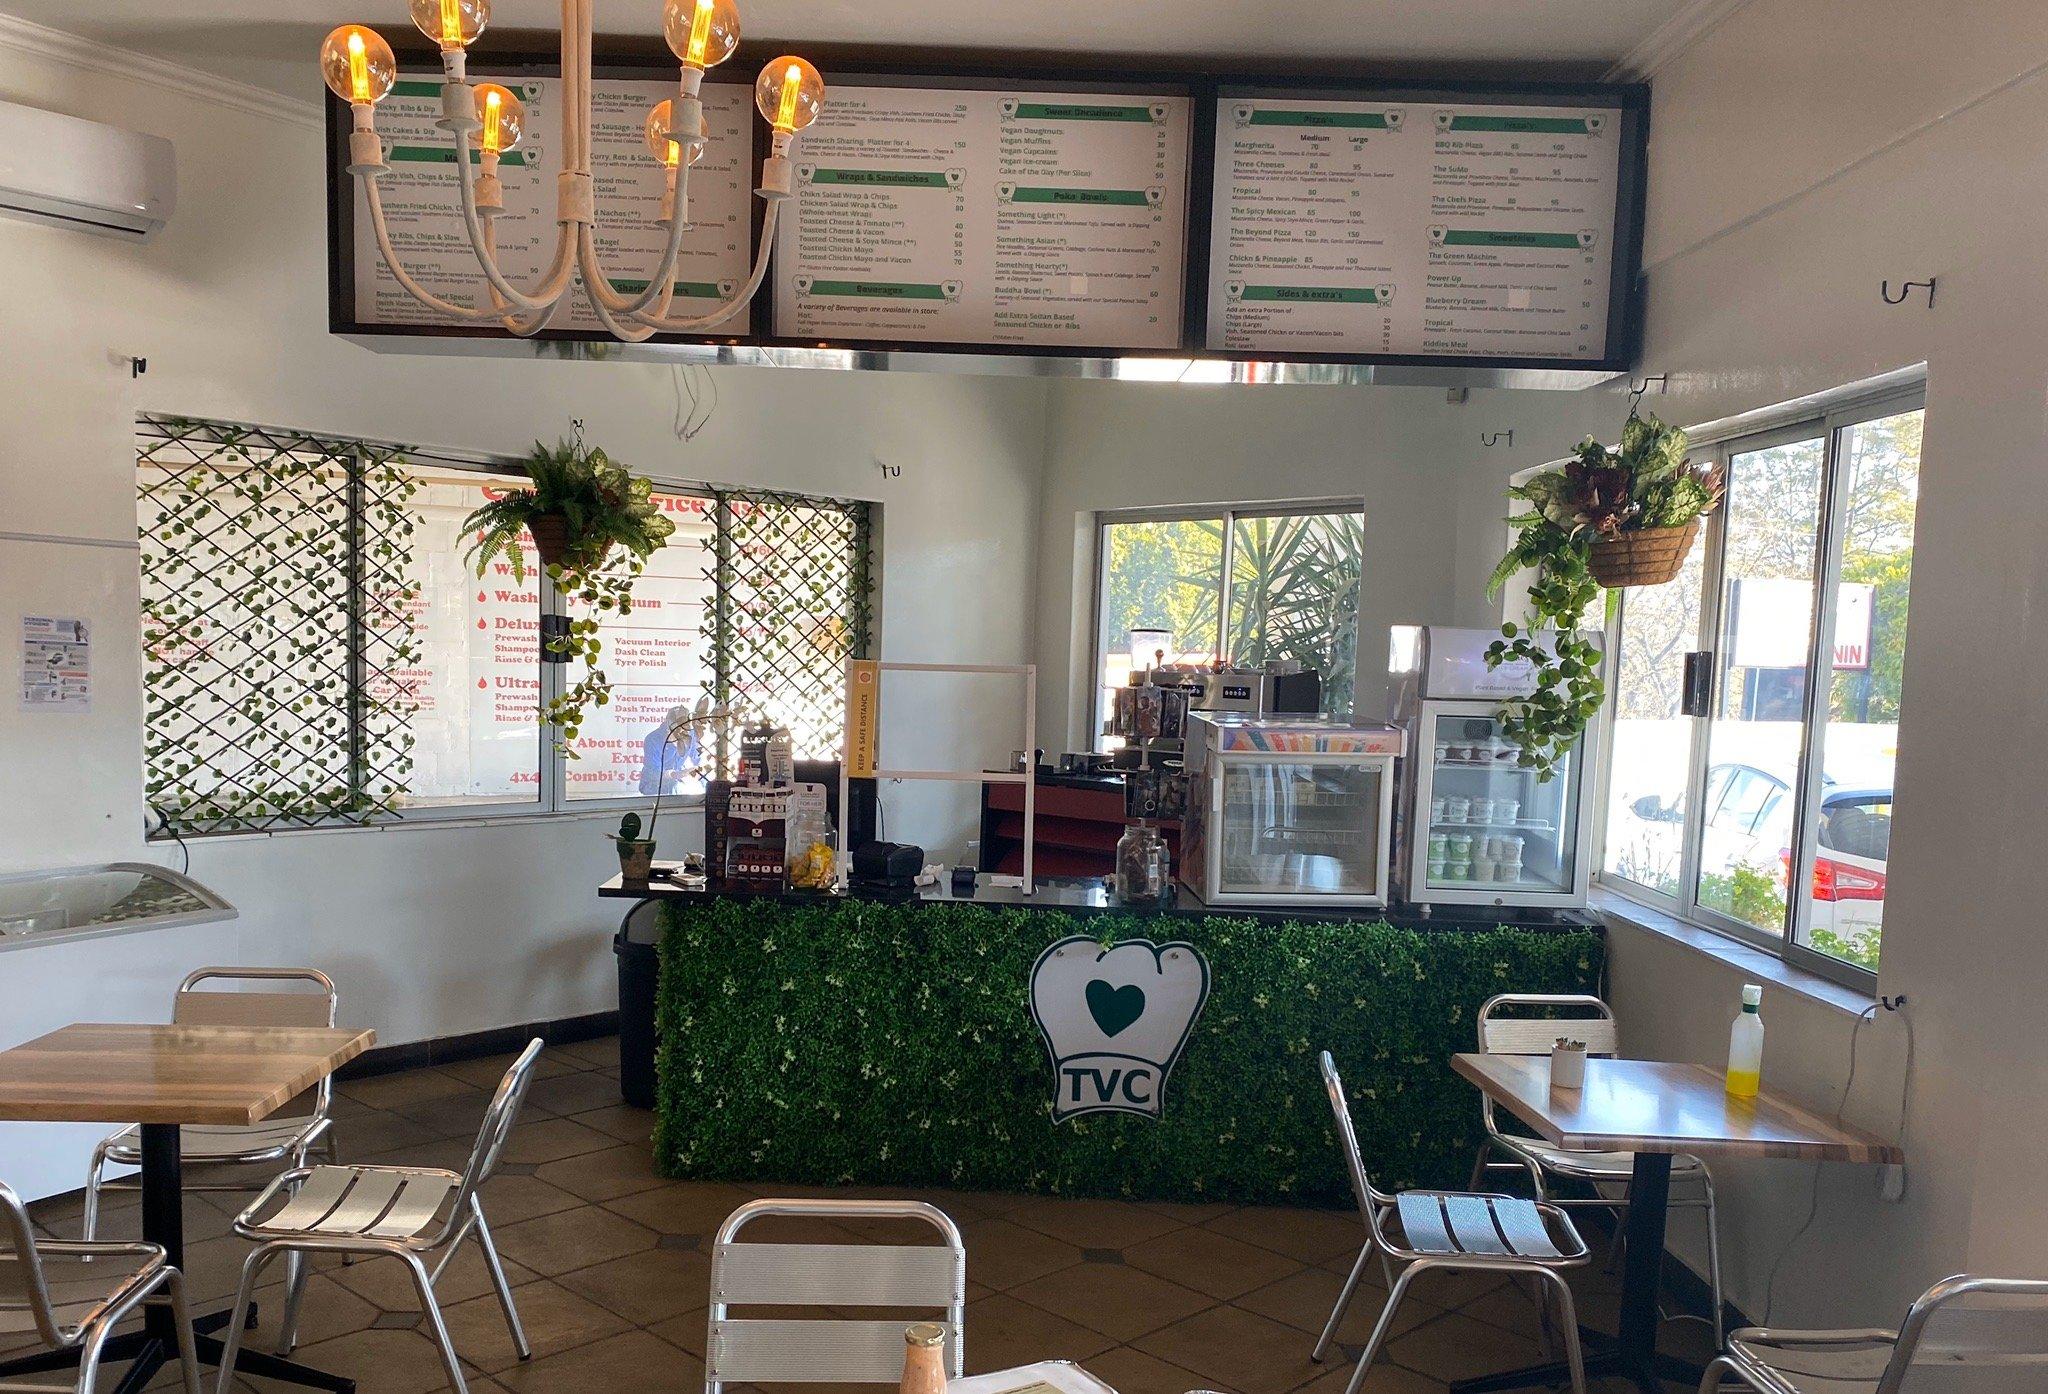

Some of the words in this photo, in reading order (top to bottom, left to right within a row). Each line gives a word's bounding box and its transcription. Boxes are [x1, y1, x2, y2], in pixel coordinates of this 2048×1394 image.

[623, 94, 647, 102] Burger
[423, 128, 435, 136] Dip
[602, 124, 630, 132] Sausage
[1000, 127, 1022, 135] Vegan
[836, 138, 864, 146] Sharing
[1349, 136, 1368, 144] Large
[1235, 142, 1274, 150] Margherita
[1000, 158, 1021, 166] Vegan
[418, 174, 436, 182] Chips
[836, 172, 865, 182] Wraps
[876, 174, 929, 183] Sandwiches
[1232, 187, 1261, 195] Tropical
[850, 202, 869, 210] Wrap
[997, 211, 1035, 220] Something
[1037, 212, 1055, 220] Light
[1246, 208, 1264, 216] Spicy
[1246, 229, 1271, 237] Beyond
[416, 234, 435, 242] Chips
[997, 236, 1034, 245] Something
[799, 244, 826, 252] Toasted
[799, 253, 826, 261] Toasted
[854, 255, 873, 263] Mayo
[1262, 256, 1297, 264] Pineapple
[996, 262, 1033, 270] Something
[1451, 275, 1461, 283] Up
[450, 293, 474, 301] Special
[1277, 290, 1300, 298] Sides
[1426, 297, 1461, 305] Blueberry
[836, 305, 867, 313] Beverages
[1425, 319, 1453, 327] Tropical
[650, 498, 706, 513] rice
[495, 591, 538, 603] Wash
[495, 617, 540, 630] Delux
[495, 634, 537, 642] Prewash
[615, 638, 652, 646] Vacuum
[615, 648, 636, 656] Dash
[524, 655, 535, 664] &
[615, 659, 636, 667] Tyre
[639, 659, 667, 667] Polish
[495, 677, 540, 689] Ultra
[495, 693, 538, 701] Prewash
[495, 704, 534, 713] Shampo
[615, 705, 638, 713] Dash
[495, 714, 521, 722] Rinse
[615, 715, 636, 723] Tyre
[577, 737, 622, 748] About
[627, 740, 644, 748] ou
[611, 753, 644, 763] Extr
[1062, 1068, 1151, 1103] TVC
